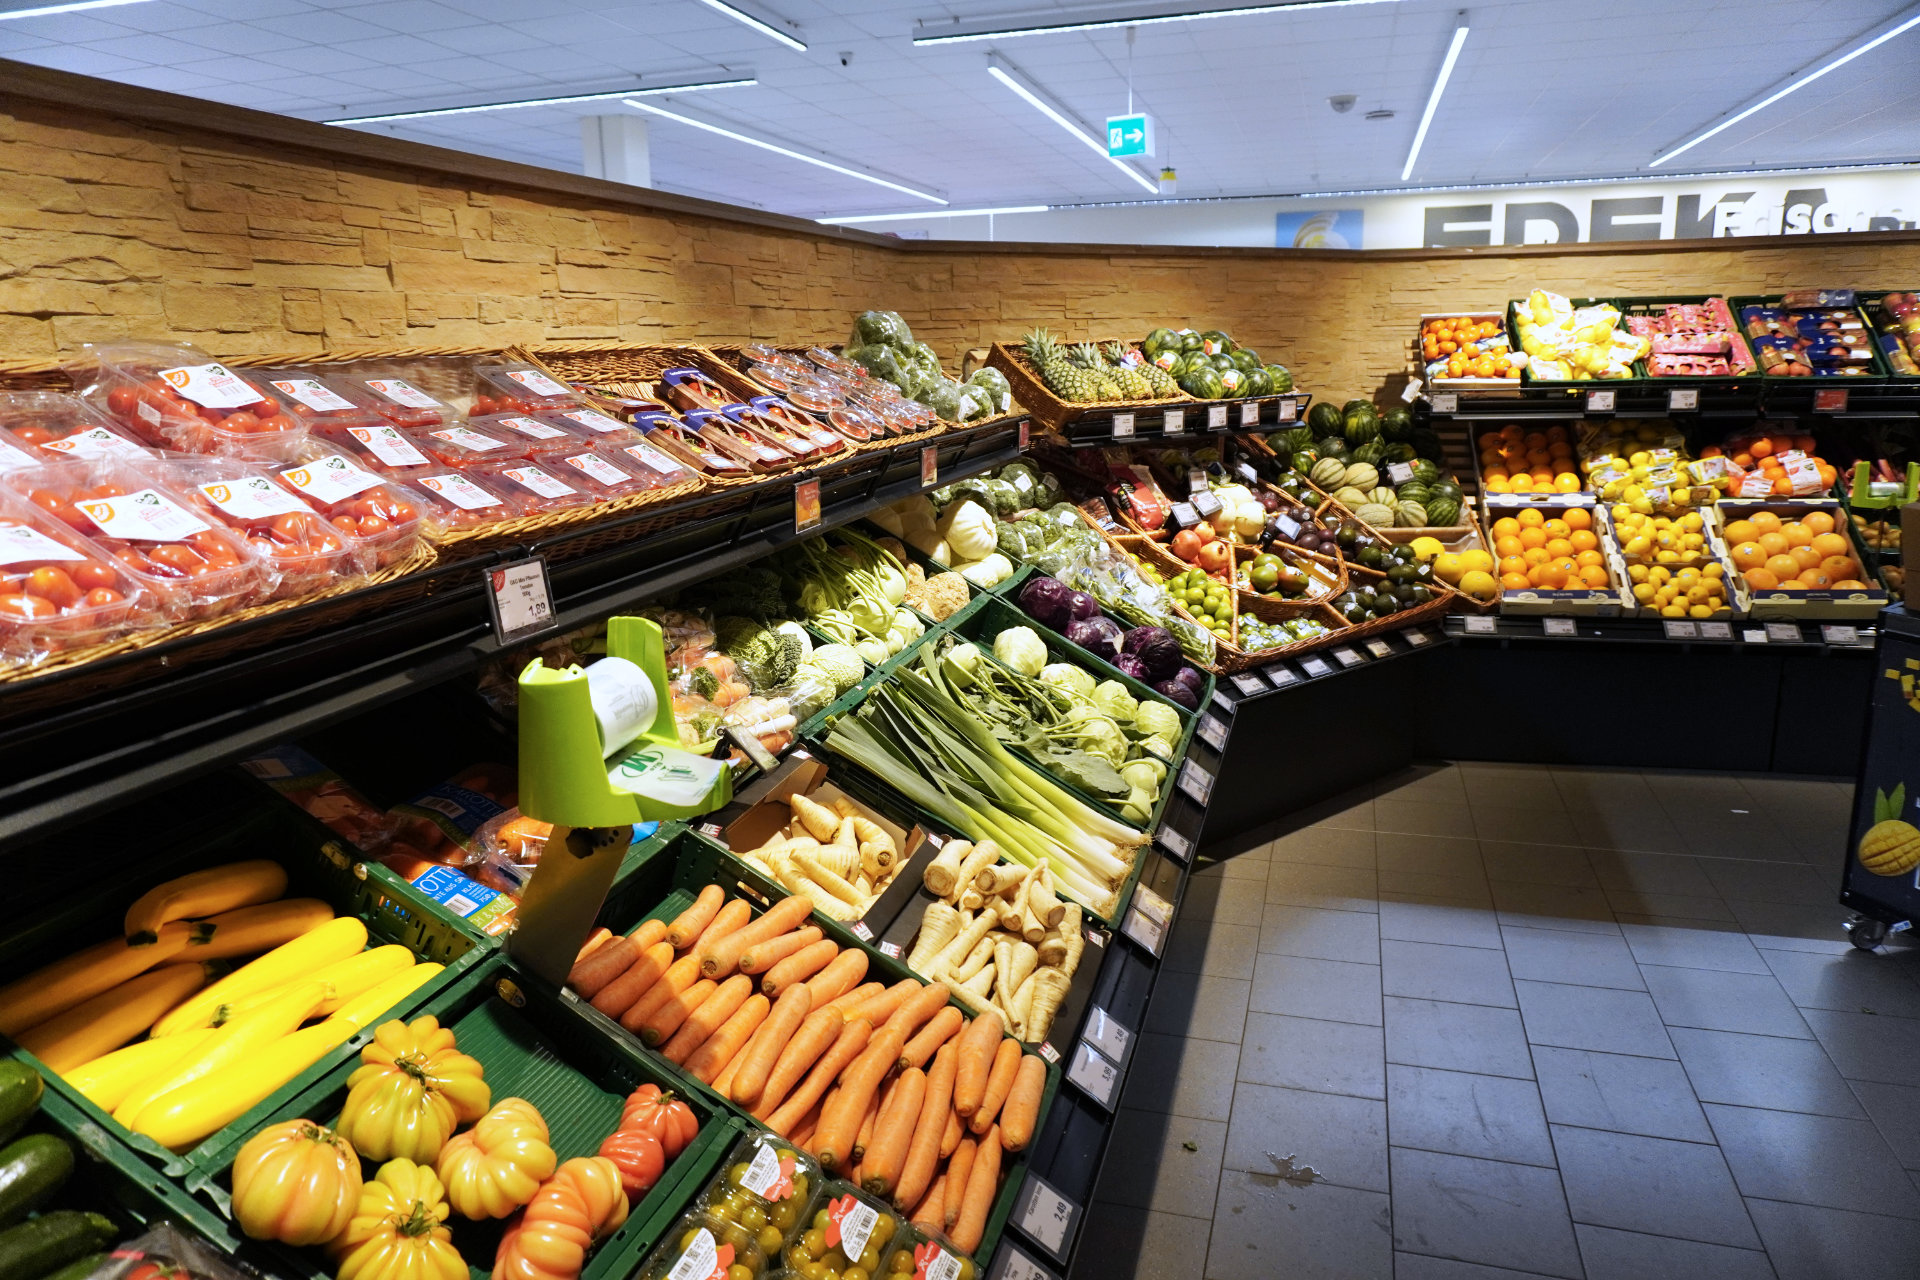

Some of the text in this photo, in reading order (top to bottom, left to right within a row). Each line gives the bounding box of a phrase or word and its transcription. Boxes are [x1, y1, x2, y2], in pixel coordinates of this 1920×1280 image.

[528, 602, 546, 617] 1,89
[479, 892, 491, 903] 750
[1053, 1201, 1067, 1221] 2,49
